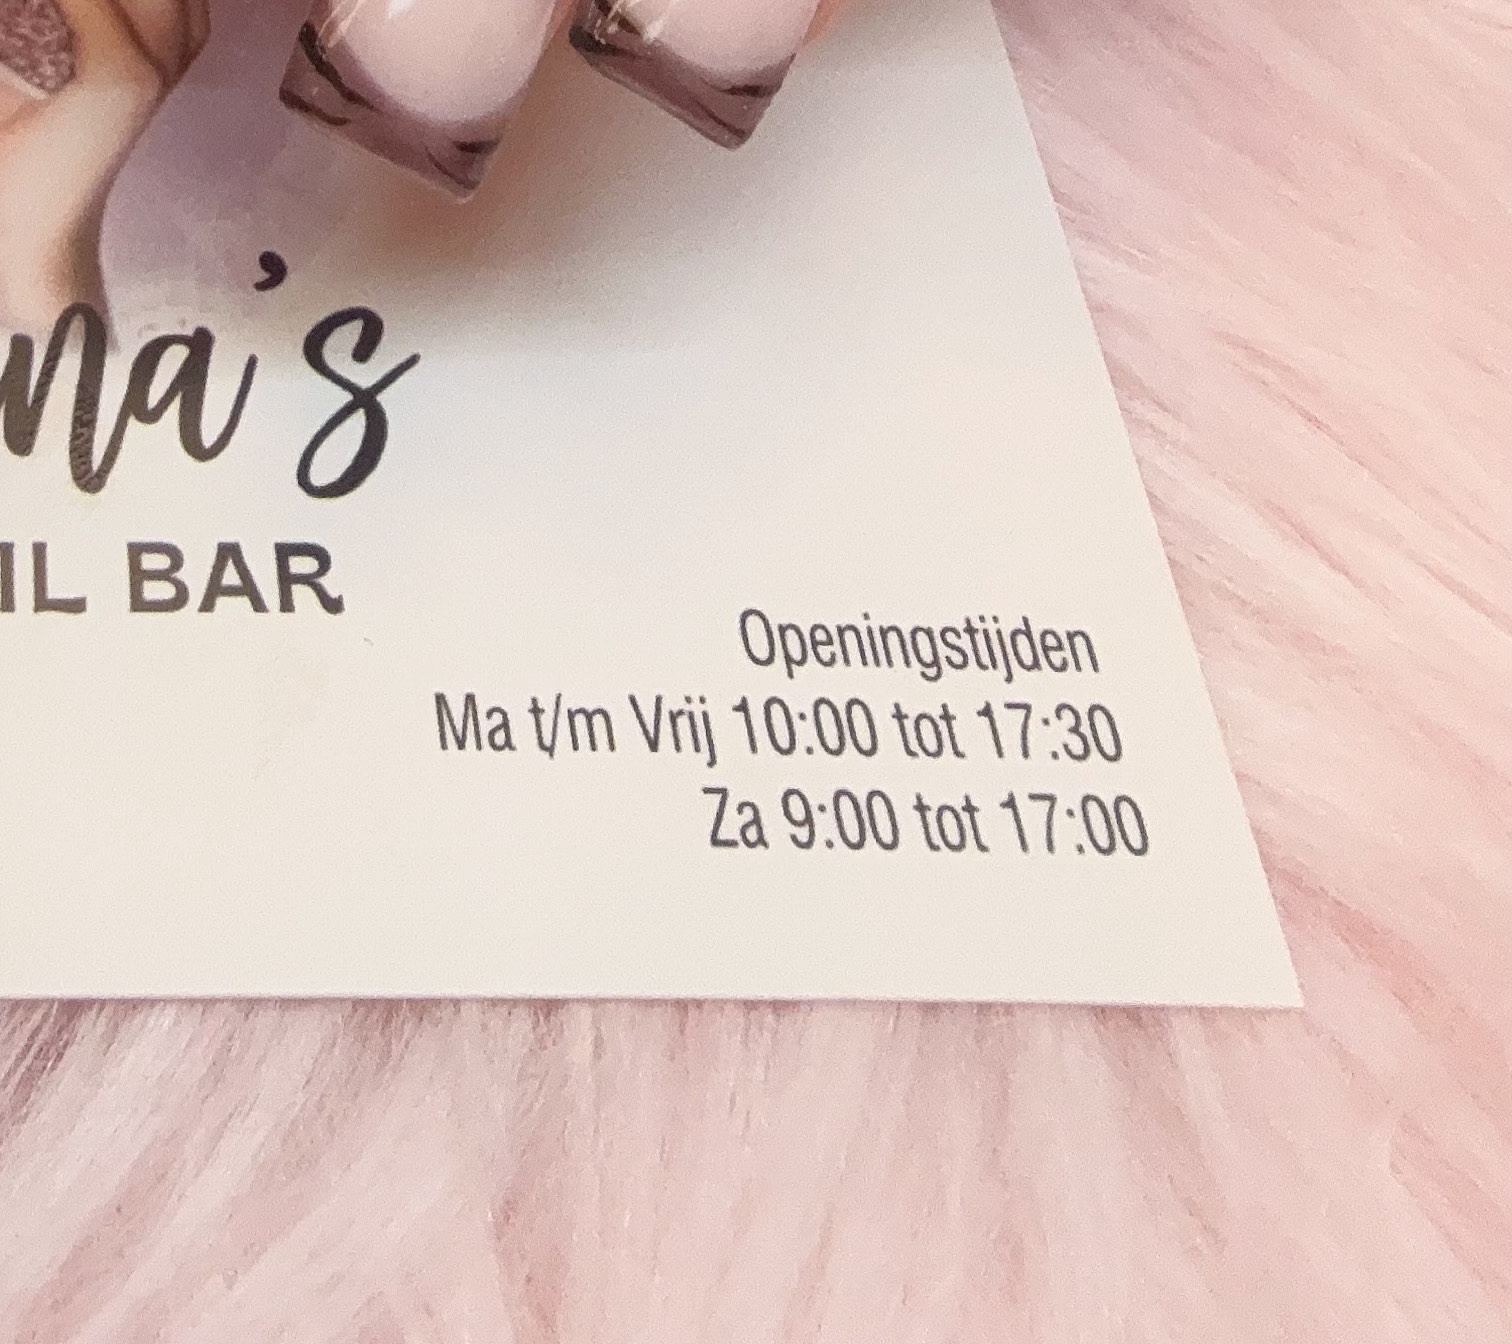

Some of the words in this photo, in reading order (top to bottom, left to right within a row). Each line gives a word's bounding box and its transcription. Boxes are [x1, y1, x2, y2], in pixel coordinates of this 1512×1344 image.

[125, 540, 346, 616] BAR
[738, 607, 1101, 684] Openingstijden
[433, 692, 517, 753] Ma
[528, 692, 617, 759] t/m
[628, 694, 718, 768] Vrij
[732, 695, 879, 758] 10:00
[891, 701, 967, 760] tot
[975, 701, 1124, 764] 17:30
[701, 786, 771, 851] Za
[781, 788, 901, 852] 9:00
[912, 793, 991, 854] tot
[999, 792, 1150, 858] 17:00
